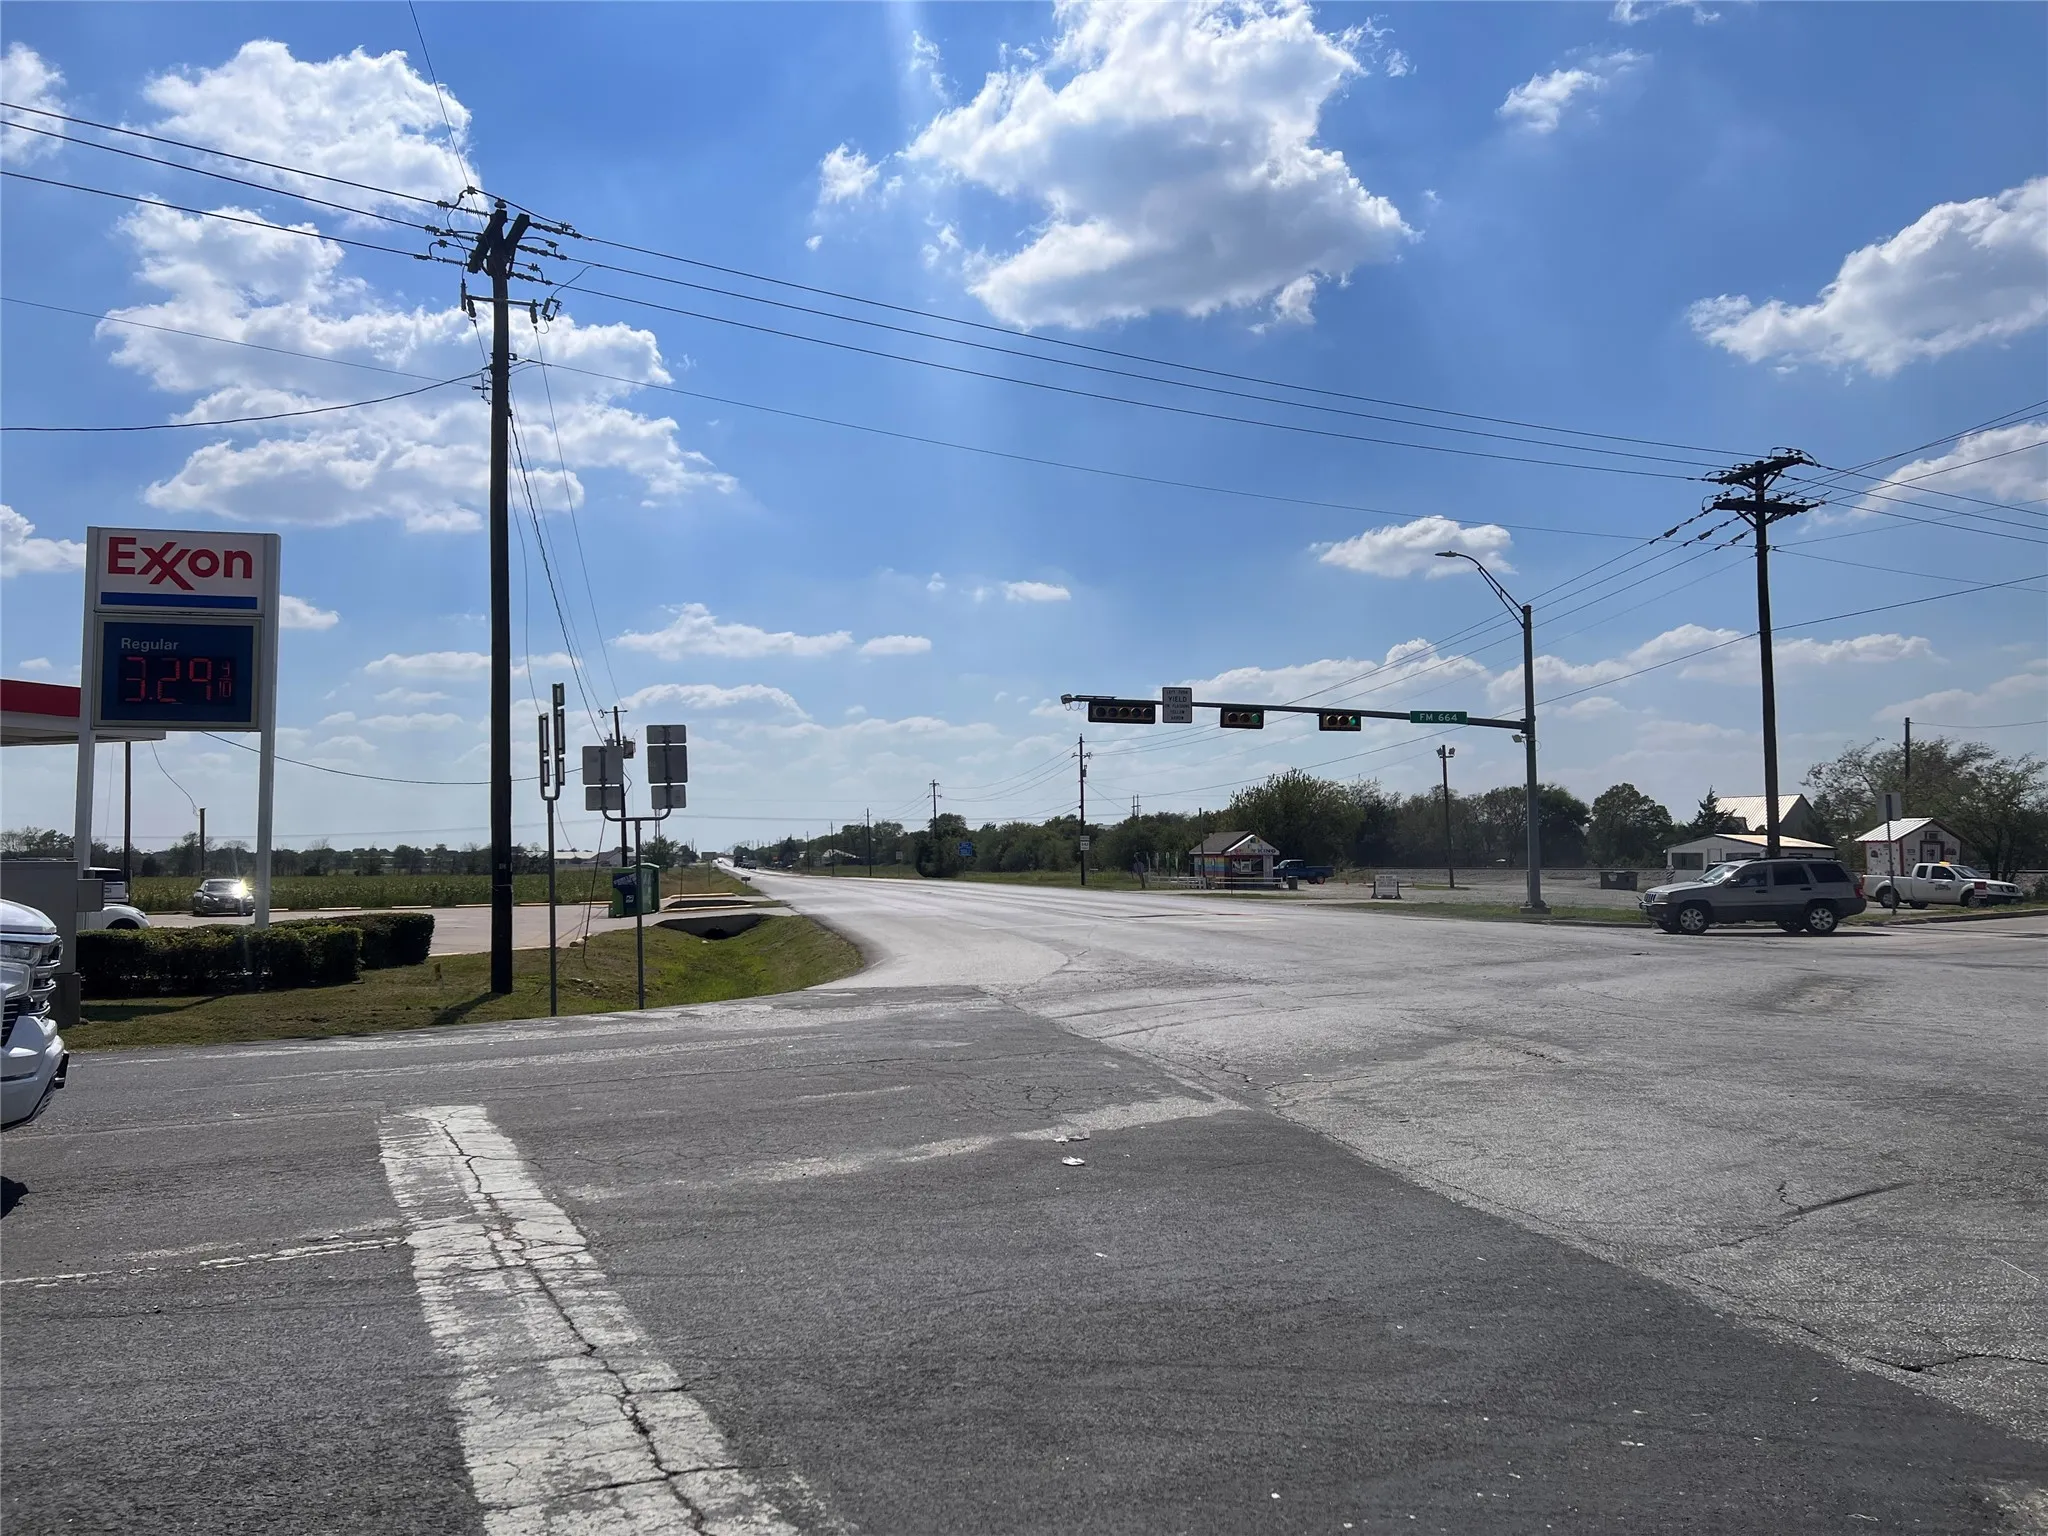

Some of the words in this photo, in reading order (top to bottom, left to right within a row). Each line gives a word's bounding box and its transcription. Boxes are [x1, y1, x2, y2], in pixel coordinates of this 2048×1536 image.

[107, 536, 253, 591] Exxon
[121, 638, 179, 652] Regular
[125, 656, 212, 703] 3.29
[1420, 713, 1433, 721] FM
[1438, 713, 1458, 722] 664
